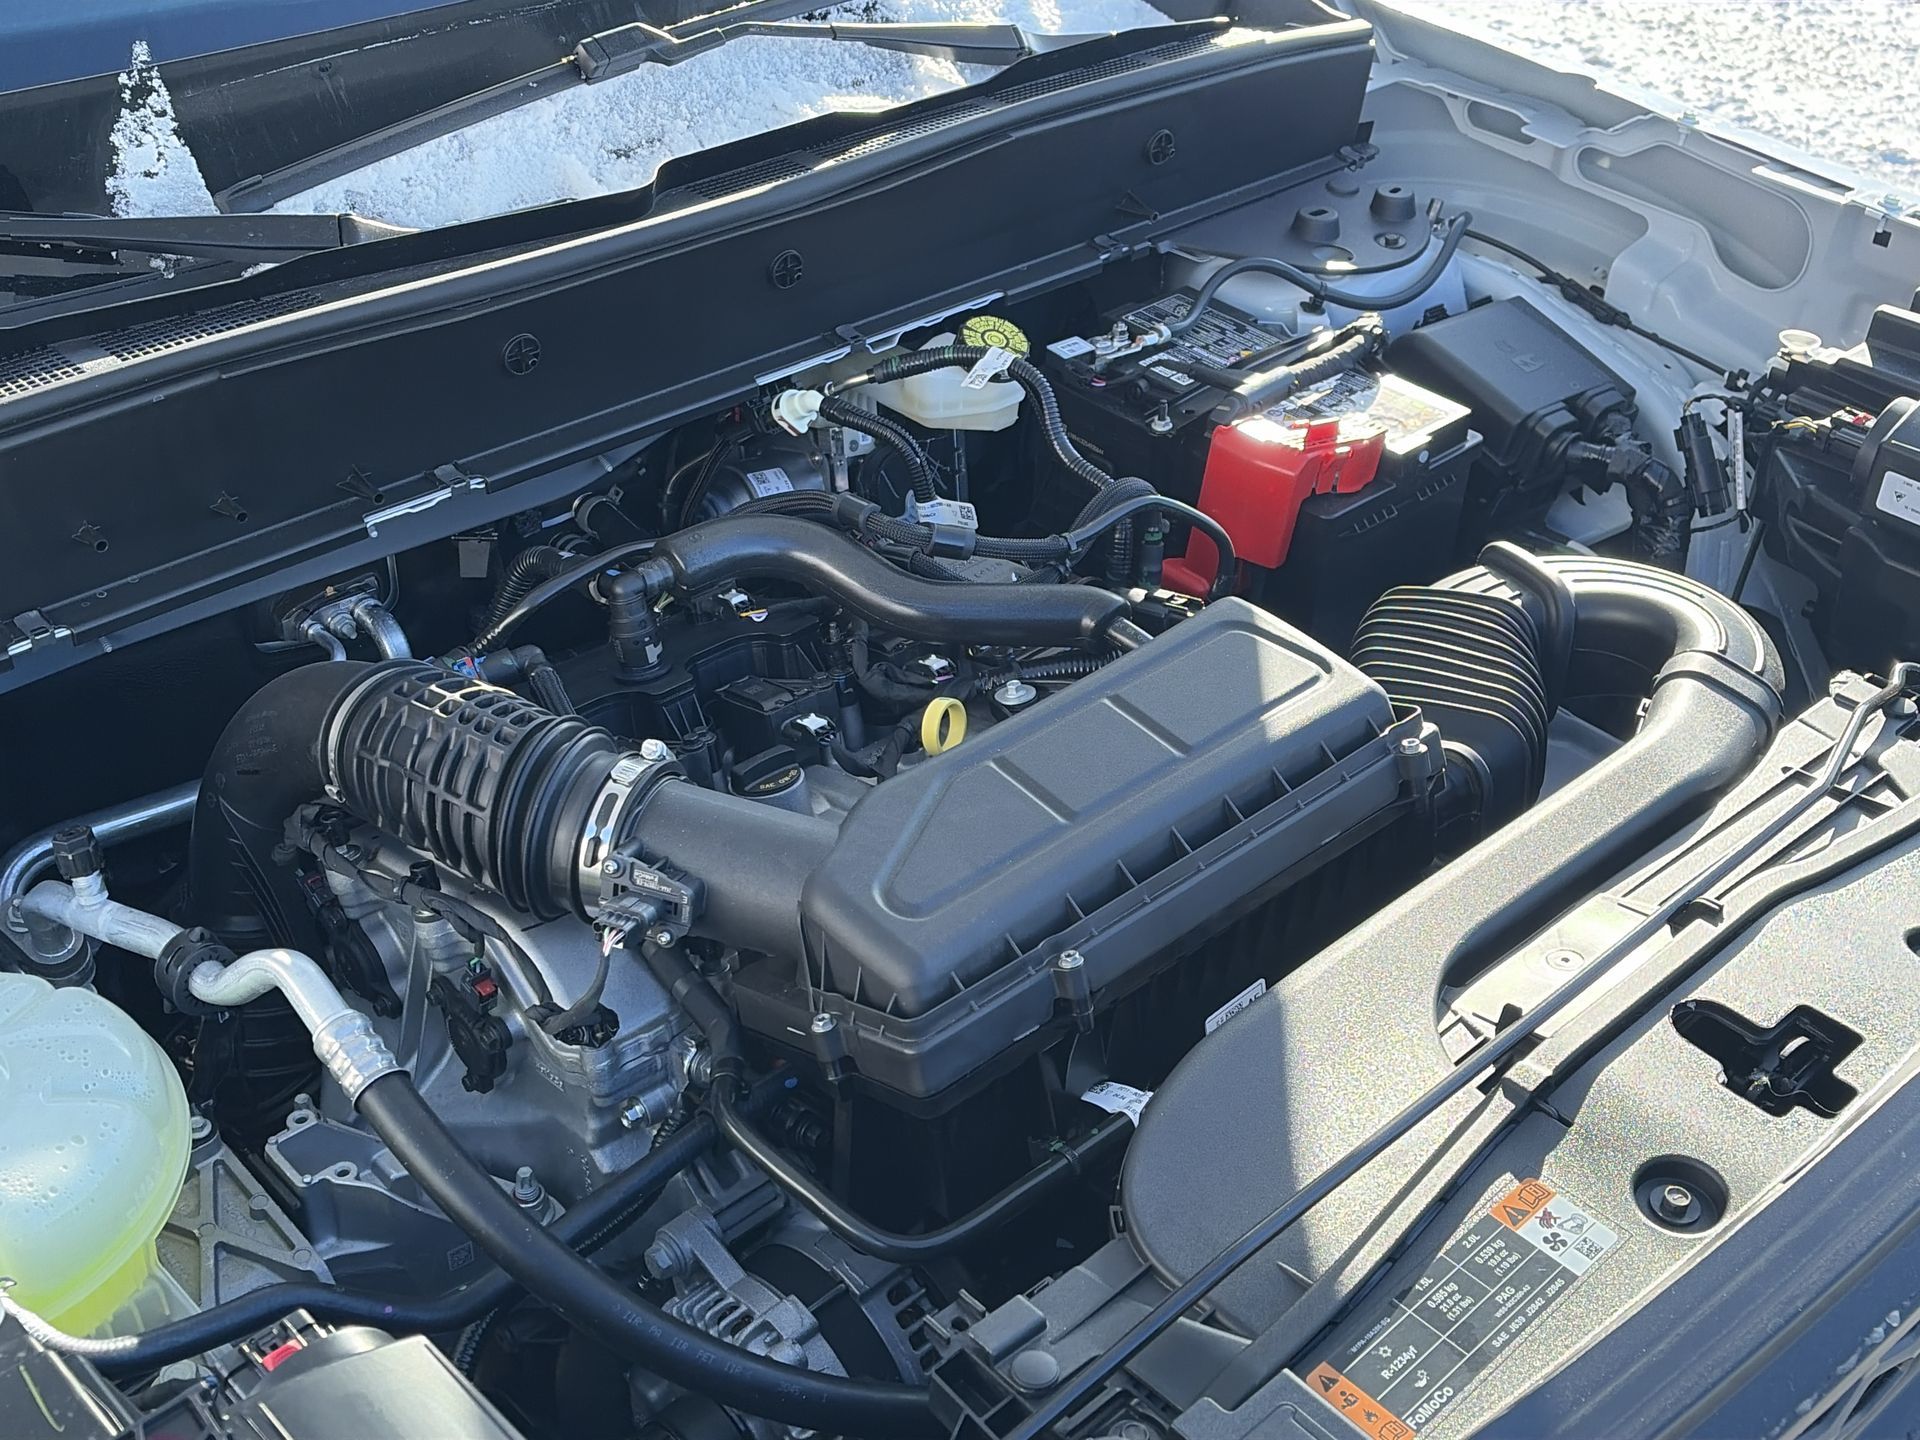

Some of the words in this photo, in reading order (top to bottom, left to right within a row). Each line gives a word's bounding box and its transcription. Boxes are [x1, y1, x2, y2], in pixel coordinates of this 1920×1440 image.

[1462, 1233, 1481, 1248] 2.0L
[1475, 1246, 1495, 1264] 0.539
[1490, 1239, 1506, 1249] kg
[1499, 1249, 1509, 1258] oz
[1506, 1252, 1522, 1264] lbs)
[1415, 1276, 1434, 1291] 1.5L
[1427, 1289, 1448, 1308] 0.595
[1443, 1282, 1459, 1292] kg
[1439, 1299, 1455, 1312] 21.0
[1452, 1292, 1462, 1301] oz
[1494, 1286, 1516, 1304] PAG
[1446, 1305, 1463, 1321] (1.31
[1459, 1295, 1475, 1308] lbs)
[1491, 1331, 1510, 1348] SAE
[1508, 1315, 1526, 1333] J639
[1525, 1297, 1546, 1317] J2842
[1545, 1278, 1566, 1297] J2845
[1381, 1344, 1418, 1379] R-1234yf
[1405, 1386, 1454, 1430] FoMoCo
